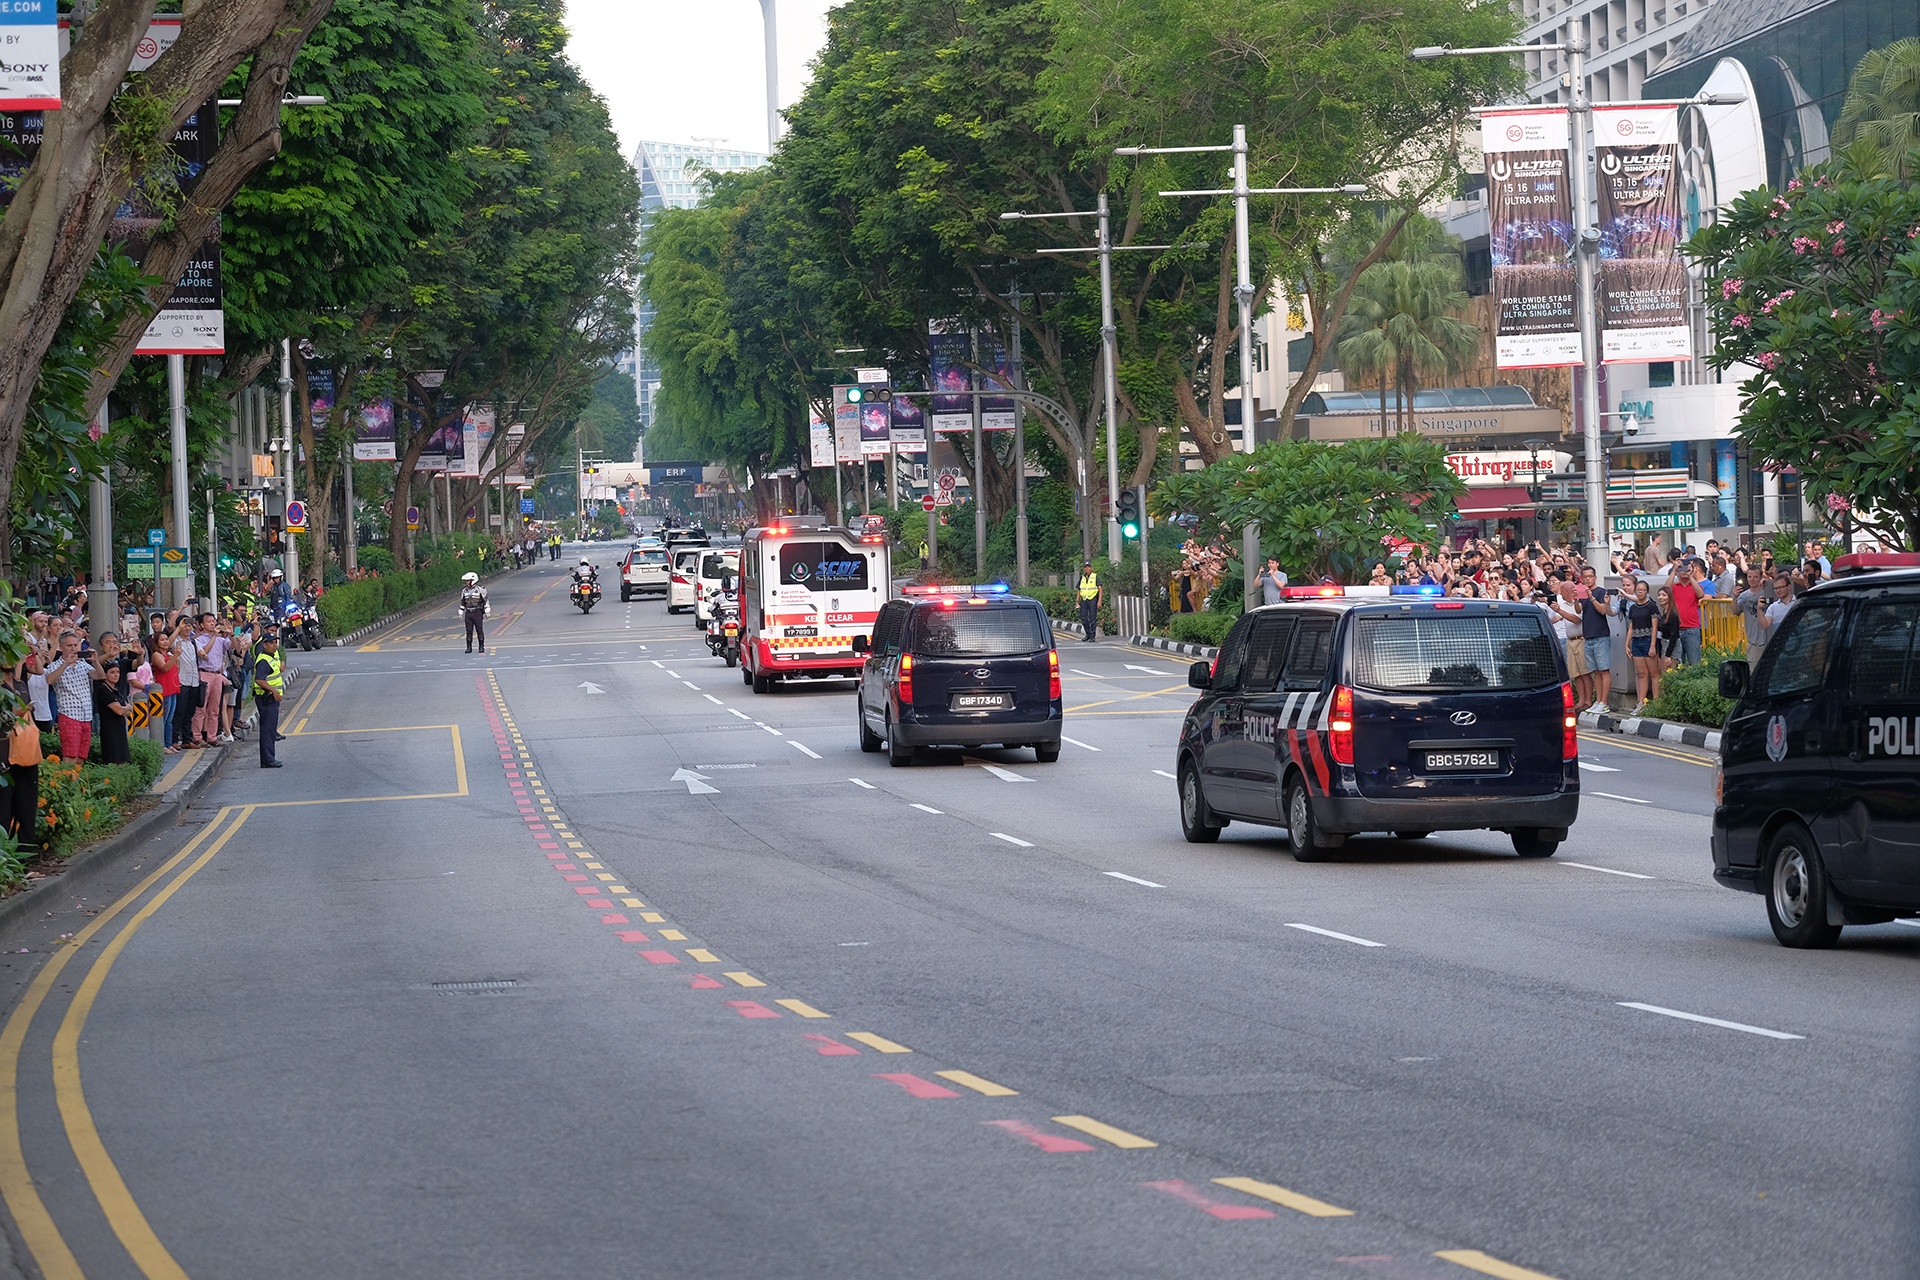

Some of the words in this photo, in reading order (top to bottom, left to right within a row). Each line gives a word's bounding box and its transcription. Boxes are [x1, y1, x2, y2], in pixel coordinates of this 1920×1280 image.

[6, 35, 21, 44] BY
[139, 44, 155, 53] SG
[1, 63, 49, 72] SONY
[25, 119, 44, 127] JUN
[22, 134, 44, 144] PAR
[174, 131, 199, 141] ARK
[1508, 130, 1521, 138] SG
[1622, 155, 1672, 164] ULTRA
[1513, 160, 1563, 170] ULTRA
[1623, 164, 1671, 173] SINGAPORE
[1514, 170, 1562, 178] SINGAPORE
[1613, 178, 1623, 187] 15
[1627, 177, 1637, 187] 16
[1644, 177, 1664, 186] JUNE
[1503, 183, 1514, 193] 15
[1517, 183, 1528, 192] 16
[1535, 182, 1555, 191] JUNE
[1613, 191, 1640, 200] ULTRA
[1643, 189, 1666, 198] PARK
[1504, 196, 1532, 205] ULTRA
[1533, 195, 1557, 204] PARK
[186, 261, 214, 269] TAGE
[188, 270, 200, 278] TO
[1608, 290, 1654, 299] WORLDWIDE
[1656, 288, 1681, 297] STAGE
[1501, 296, 1546, 305] WORLDWIDE
[1548, 294, 1573, 303] STAGE
[1629, 297, 1659, 305] COMING
[1521, 303, 1551, 311] COMING
[1610, 304, 1635, 312] ULTRA
[1637, 302, 1680, 311] SINGAPORE
[1503, 311, 1527, 319] ULTRA
[1529, 308, 1572, 318] SINGAPORE
[1501, 322, 1575, 331] WWW.ULTRASINGAPORE.COM
[1421, 416, 1499, 433] Singapore
[666, 468, 687, 476] ERP
[1447, 455, 1513, 482] Shiraz
[1617, 516, 1675, 531] CUSCADEN
[1678, 514, 1693, 528] RD
[815, 561, 862, 575] SCDF
[827, 614, 854, 622] CLEAR
[959, 696, 1003, 705] GBF1734D
[1243, 716, 1275, 743] POLICE
[1426, 753, 1497, 768] GBC5762L
